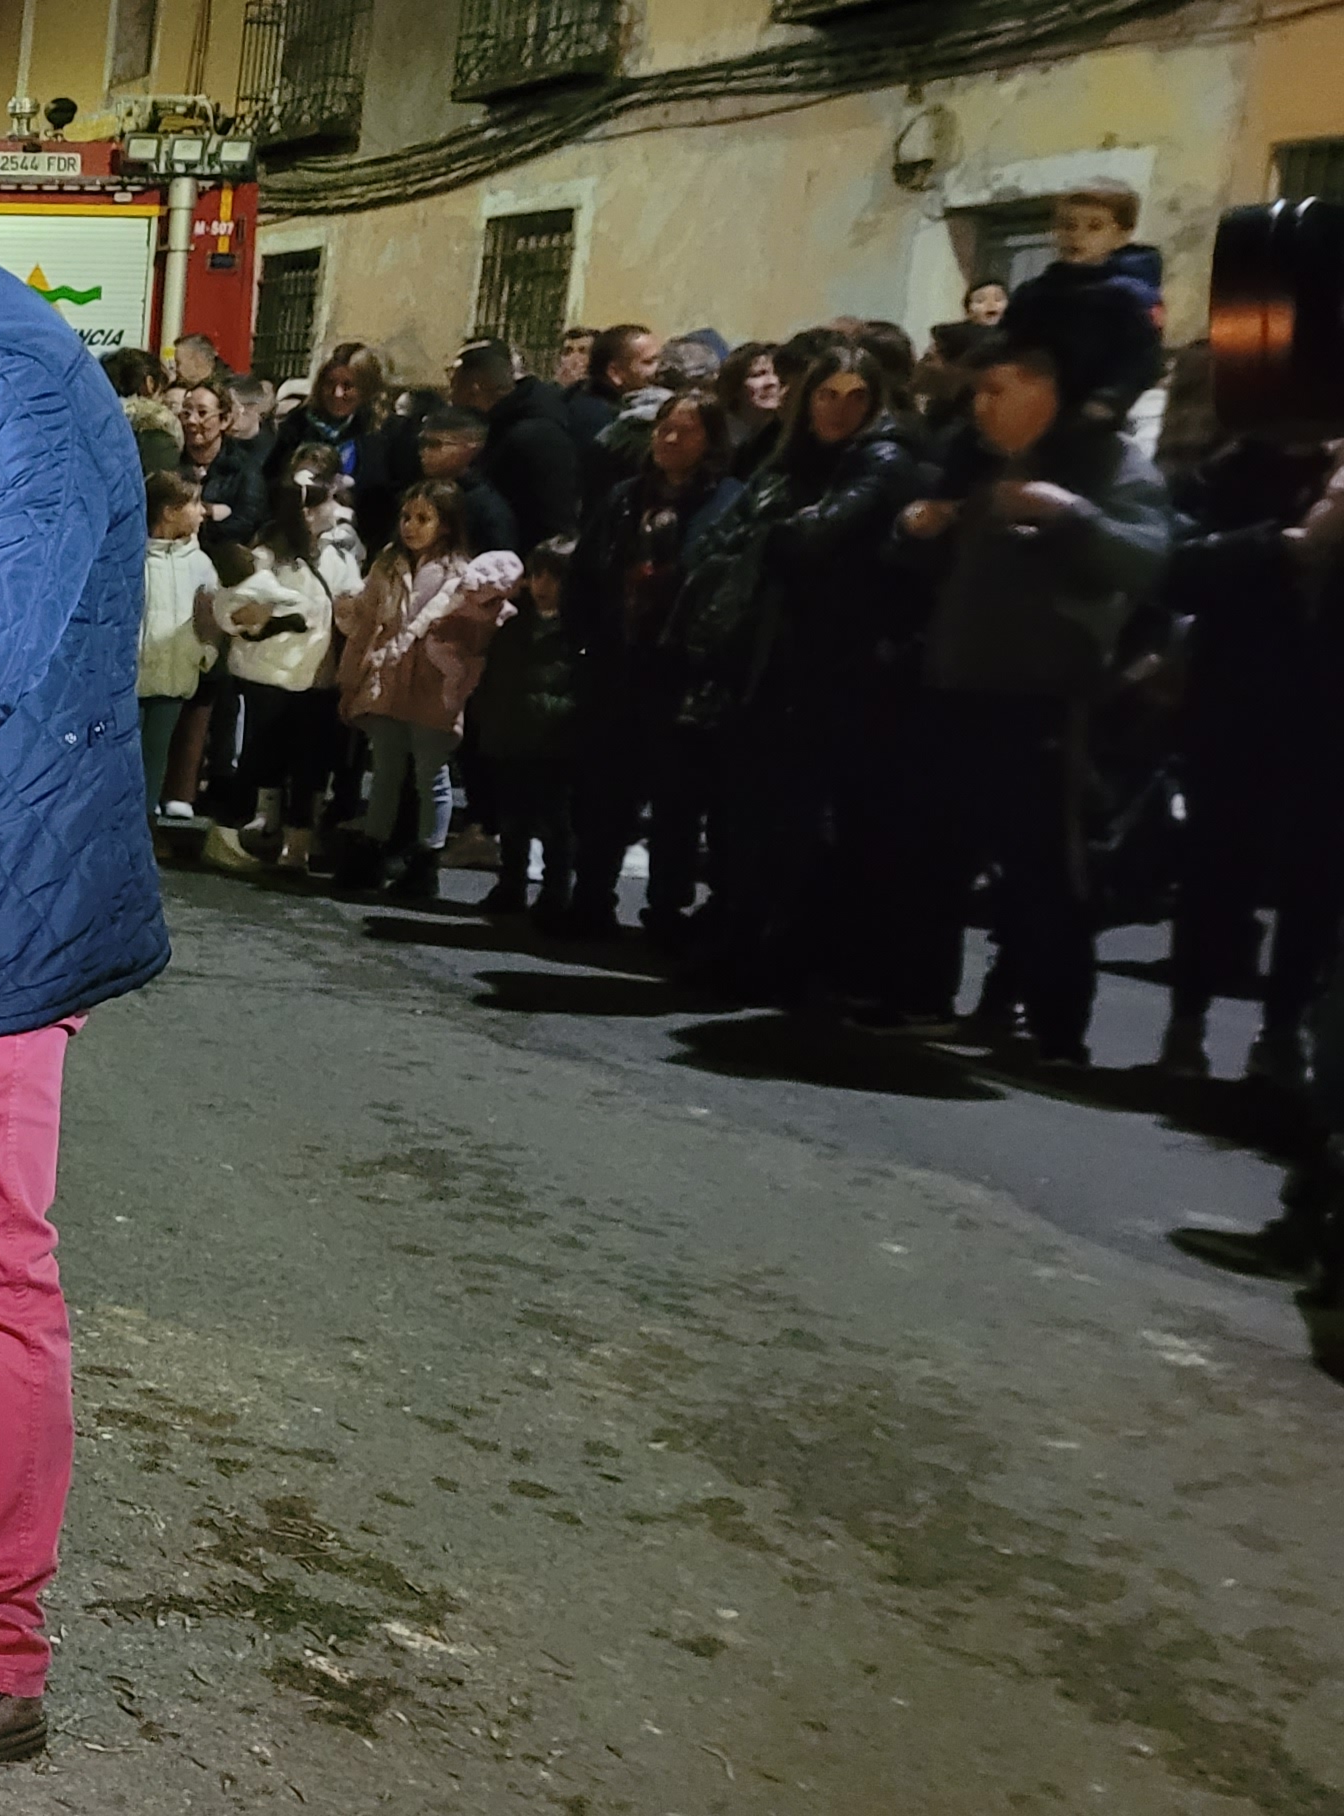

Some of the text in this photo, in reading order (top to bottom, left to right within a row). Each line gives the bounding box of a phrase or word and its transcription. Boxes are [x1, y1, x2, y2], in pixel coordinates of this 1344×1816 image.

[0, 155, 77, 172] 2544 FDR
[73, 328, 125, 346] NCIA
